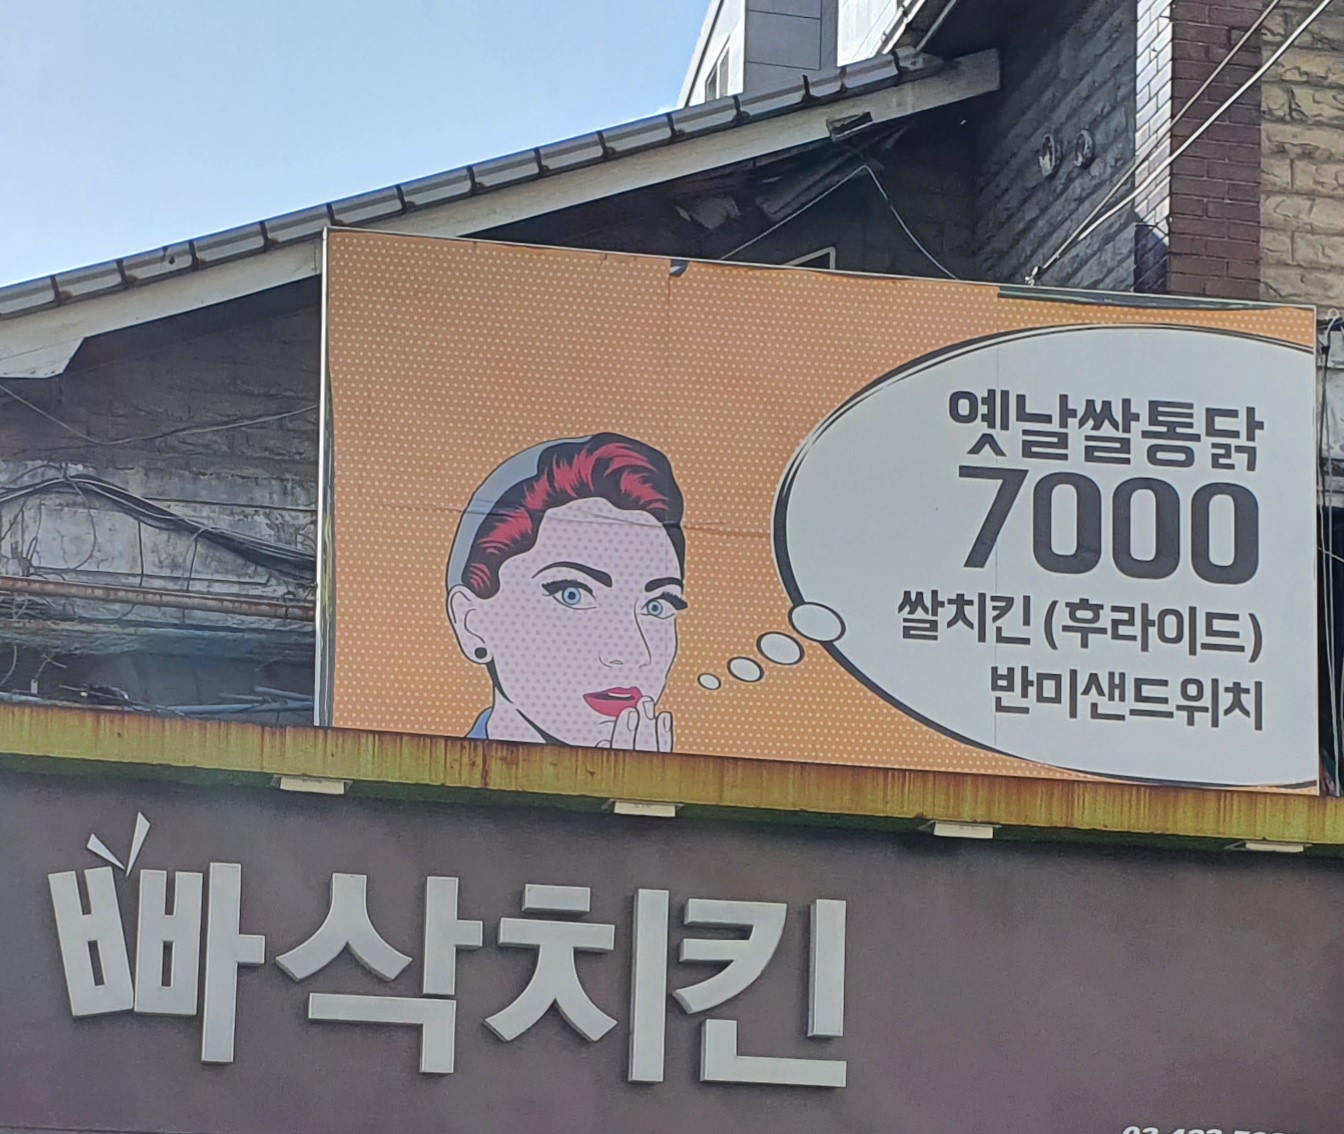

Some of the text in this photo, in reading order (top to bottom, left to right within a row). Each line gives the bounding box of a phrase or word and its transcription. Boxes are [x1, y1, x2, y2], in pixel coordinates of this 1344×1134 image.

[949, 388, 1264, 471] 옛날쌀통닭
[958, 465, 1260, 585] 7000
[897, 589, 1263, 663] 쌀치킨 (후라이드)
[990, 665, 1263, 731] 반미샌드위치
[47, 814, 849, 1088] 빠삭치킨
